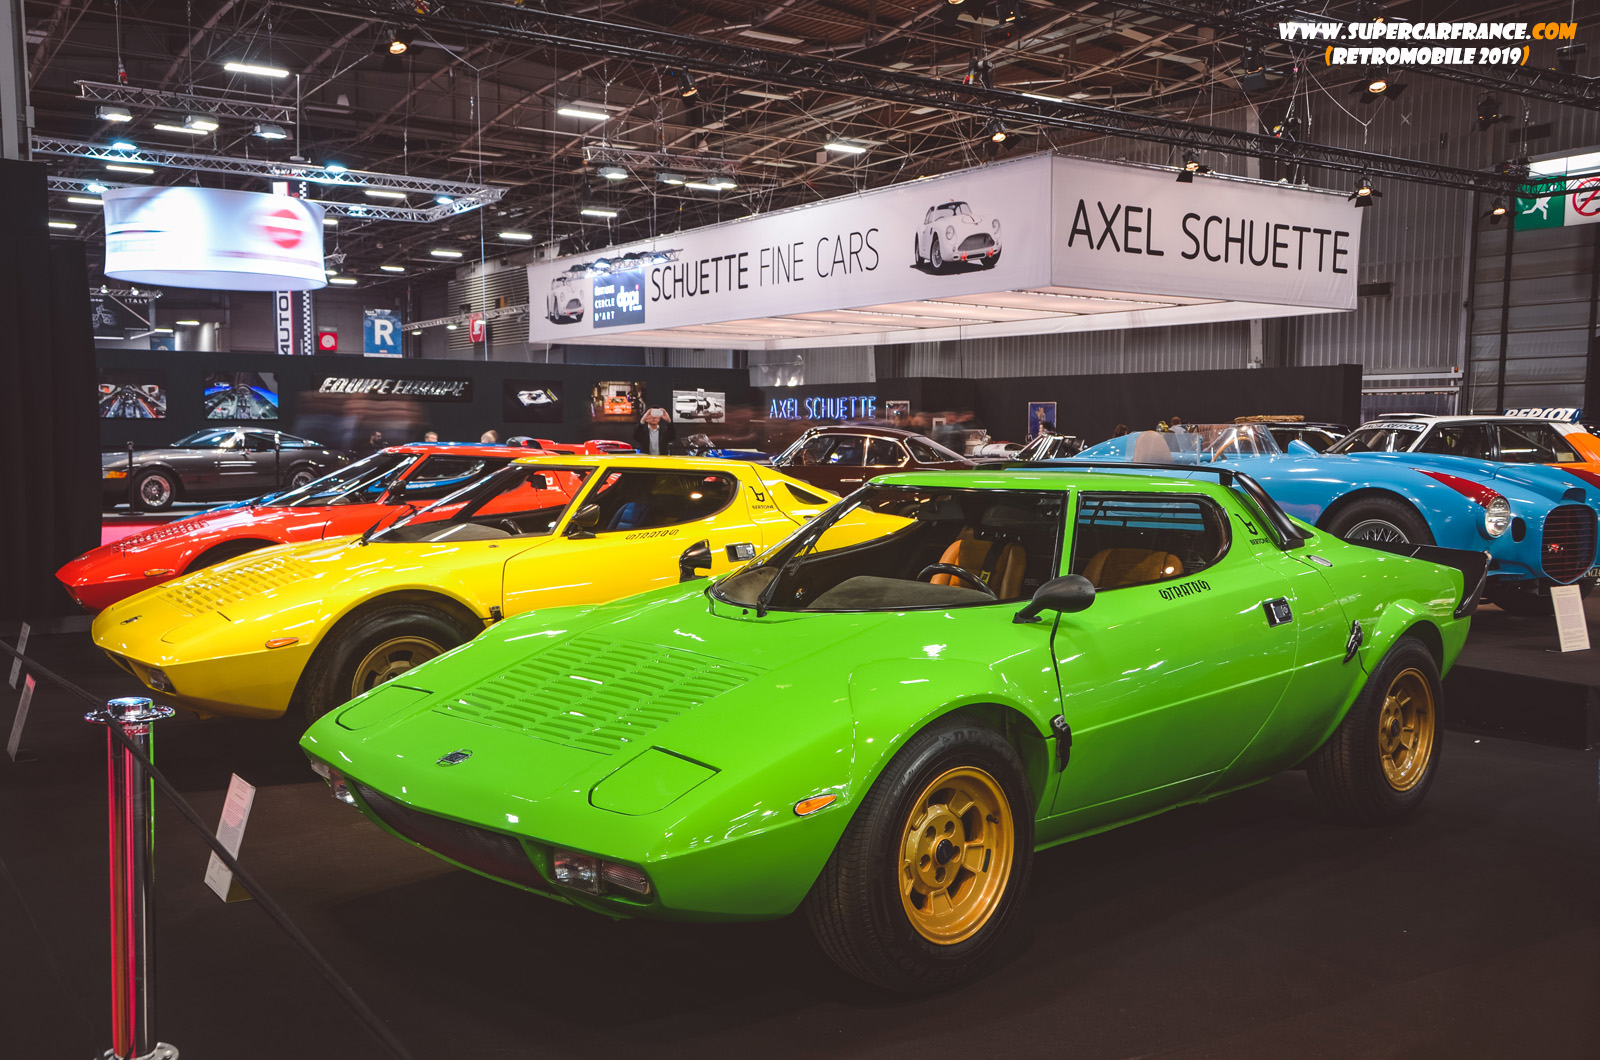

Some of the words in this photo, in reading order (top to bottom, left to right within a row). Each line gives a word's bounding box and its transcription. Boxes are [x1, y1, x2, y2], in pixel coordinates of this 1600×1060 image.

[1068, 199, 1164, 256] AXEL
[1181, 212, 1350, 274] SCHUETTE
[651, 251, 749, 302] SCHUETTE
[759, 241, 804, 287] FINE
[816, 228, 879, 278] CARS
[594, 298, 615, 309] CERCLE
[279, 290, 290, 355] AUTO
[594, 311, 615, 321] D'ART
[375, 319, 394, 345] R
[318, 377, 394, 395] EQUIPE
[769, 398, 801, 420] AXEL
[804, 396, 877, 420] SCHUETTE
[625, 529, 679, 540] STRATOS
[1158, 579, 1211, 601] STRATOS
